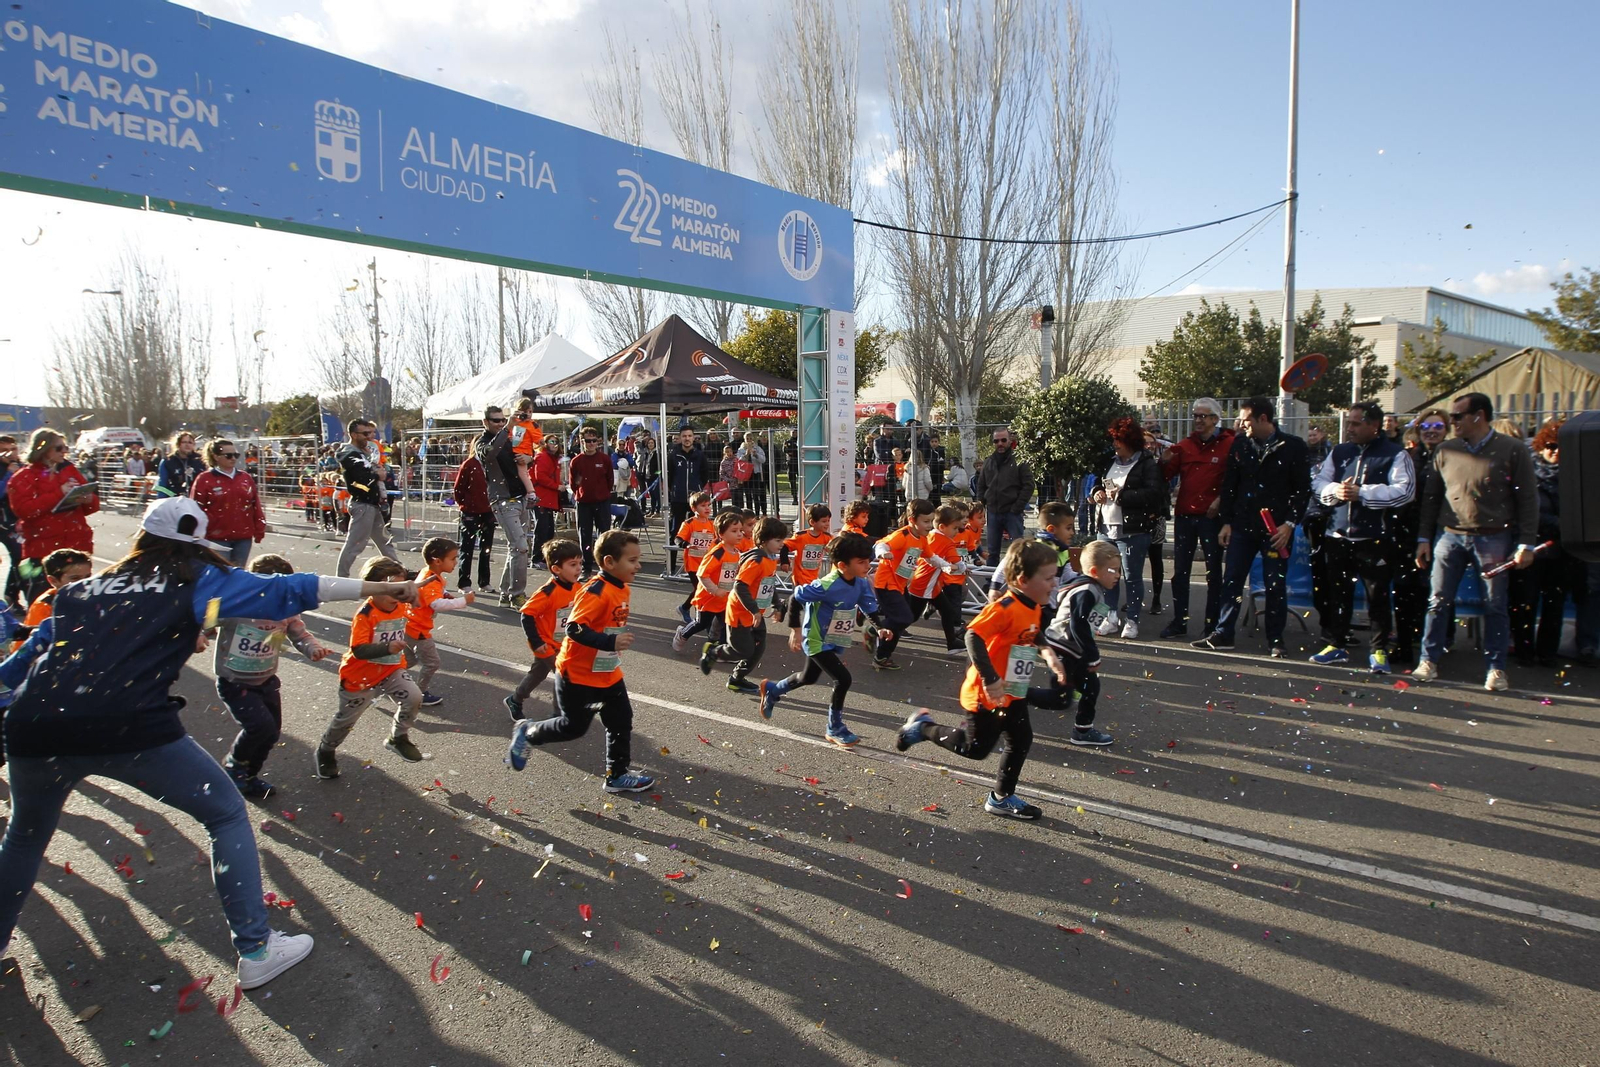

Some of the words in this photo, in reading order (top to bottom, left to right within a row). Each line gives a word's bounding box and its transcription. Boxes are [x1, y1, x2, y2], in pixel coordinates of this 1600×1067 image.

[33, 25, 158, 78] MEDIO
[35, 60, 219, 127] MARATÓN
[37, 97, 203, 152] ALMERÍA
[401, 127, 557, 194] ALMERÍA
[401, 167, 486, 203] CIUDAD
[671, 194, 717, 219] MEDIO
[671, 214, 740, 244] MARATÓN
[671, 235, 733, 261] ALMERÍA
